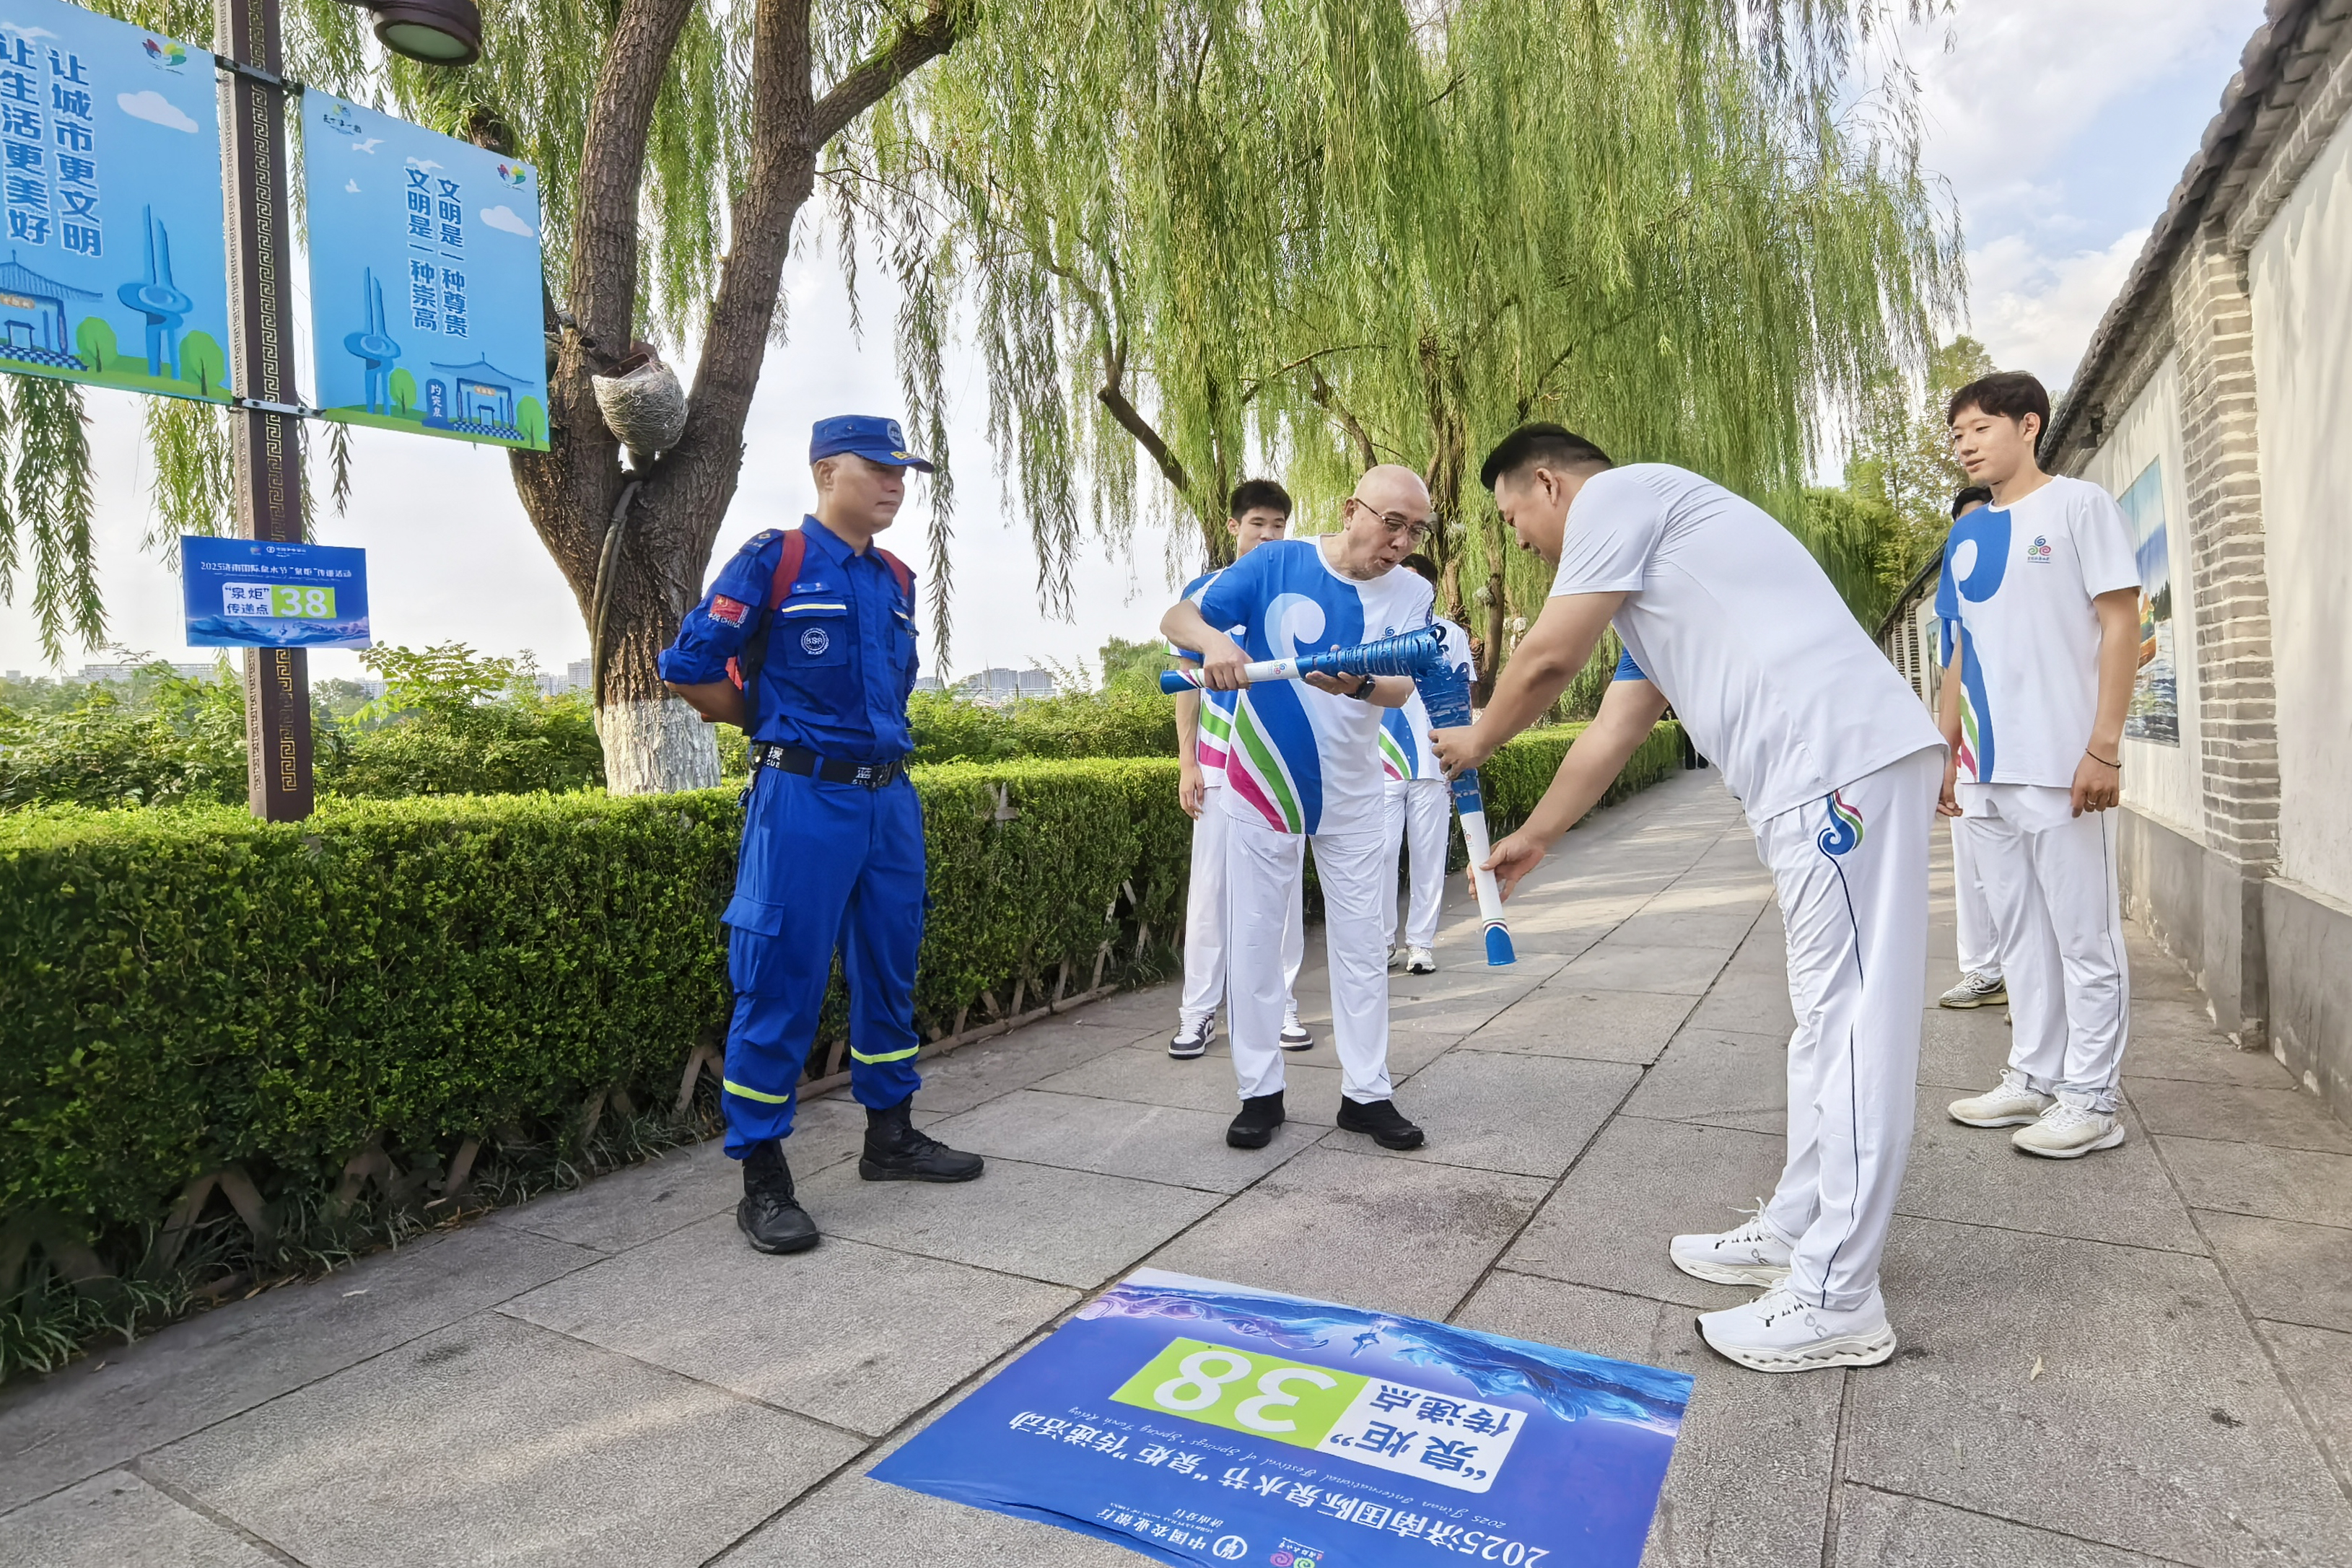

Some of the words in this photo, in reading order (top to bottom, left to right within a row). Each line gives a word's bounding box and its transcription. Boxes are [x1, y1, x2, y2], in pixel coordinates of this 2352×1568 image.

[0, 33, 51, 245] 让生活更美好
[48, 48, 101, 256] 让城市更文明
[405, 167, 437, 332] 文明是一种崇高
[437, 178, 468, 338] 文明是一种尊贵
[227, 603, 269, 615] 传递点
[279, 587, 328, 616] 38
[1153, 1351, 1338, 1433] 38
[1368, 1385, 1511, 1437] 传递点
[1238, 1451, 1256, 1461] of
[1259, 1458, 1317, 1478] Festival
[1329, 1421, 1487, 1481] “泉炬”
[1319, 1473, 1414, 1504] International
[1422, 1501, 1469, 1518] Jinan
[1096, 1508, 1207, 1551] 中国农业银行
[1472, 1515, 1507, 1529] 2025
